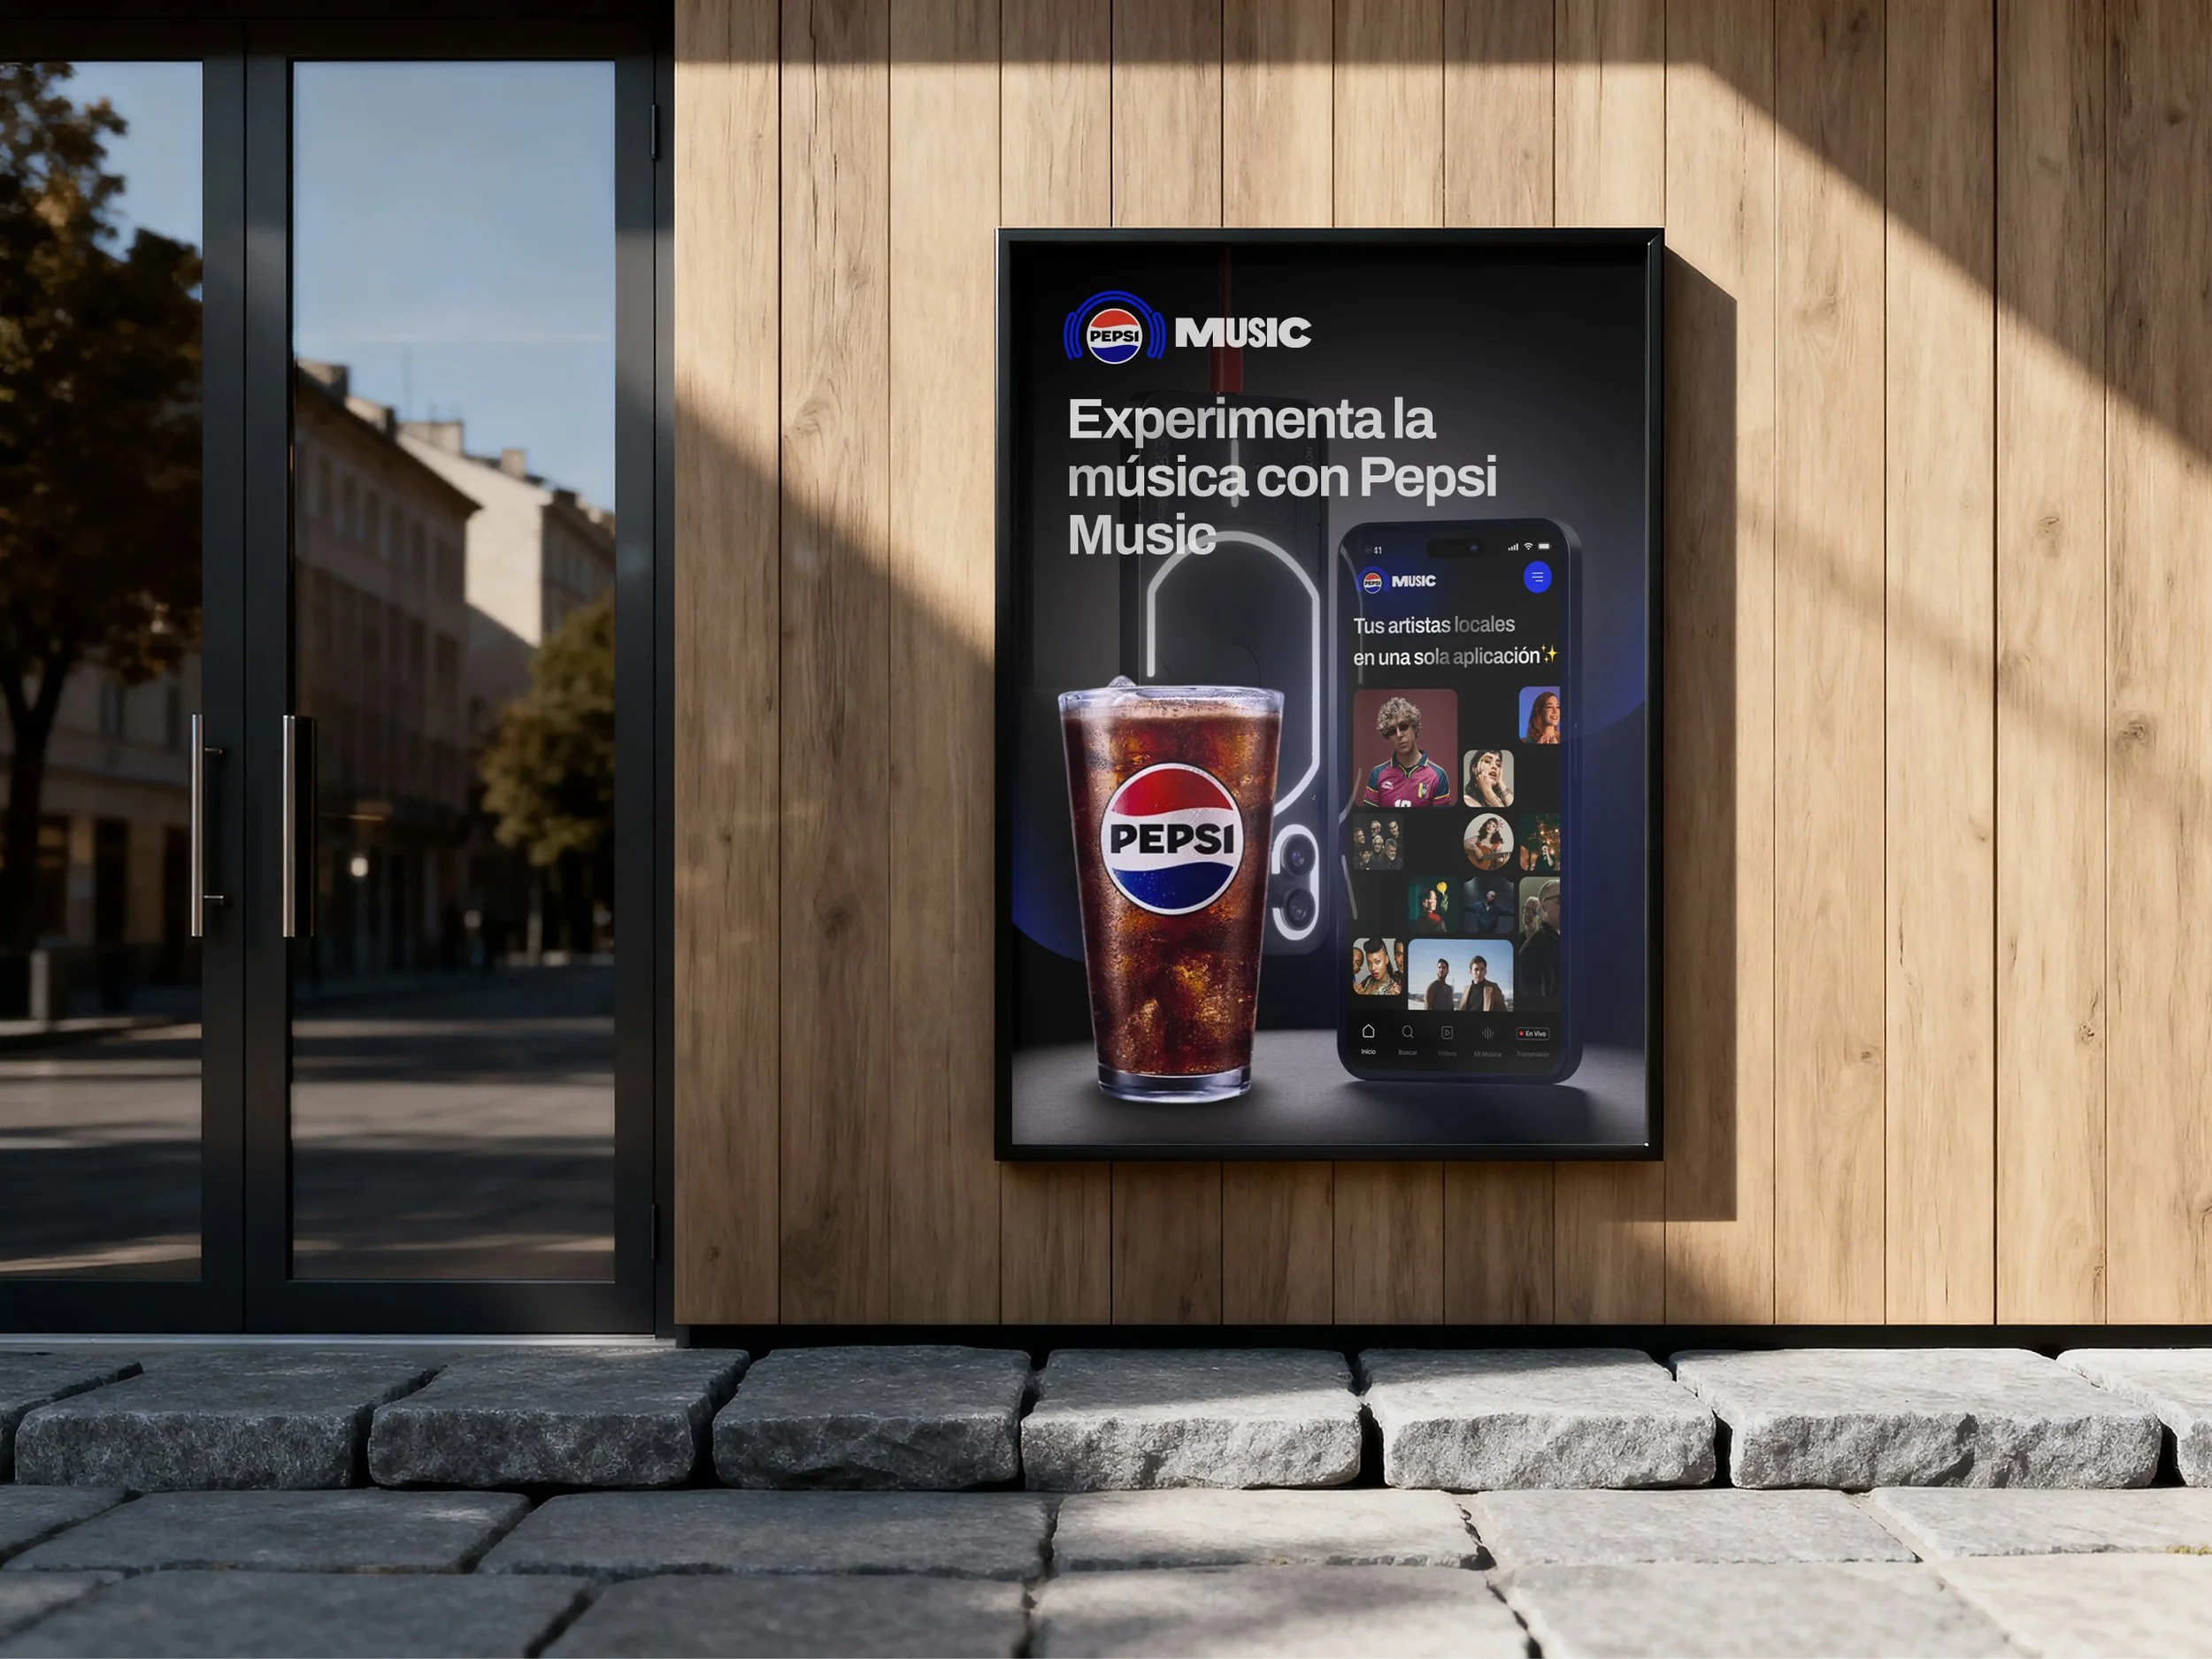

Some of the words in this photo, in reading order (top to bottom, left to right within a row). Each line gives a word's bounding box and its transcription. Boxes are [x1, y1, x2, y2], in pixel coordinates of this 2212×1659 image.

[1090, 330, 1139, 342] PEPSI
[1175, 317, 1312, 349] MUSIC
[1069, 396, 1386, 449] Experimenta
[1394, 396, 1438, 441] la
[1069, 454, 1250, 497] música
[1257, 465, 1349, 497] con
[1361, 454, 1497, 507] Pepsi
[1069, 513, 1217, 556] Music
[1391, 574, 1437, 588] MUSIC
[1353, 617, 1386, 634] Tus
[1388, 616, 1452, 634] artistas
[1454, 614, 1516, 634] locales
[1353, 651, 1375, 666] en
[1378, 651, 1412, 666] una
[1413, 647, 1451, 666] sola
[1453, 645, 1541, 669] aplicación
[1110, 823, 1234, 855] PEPSI
